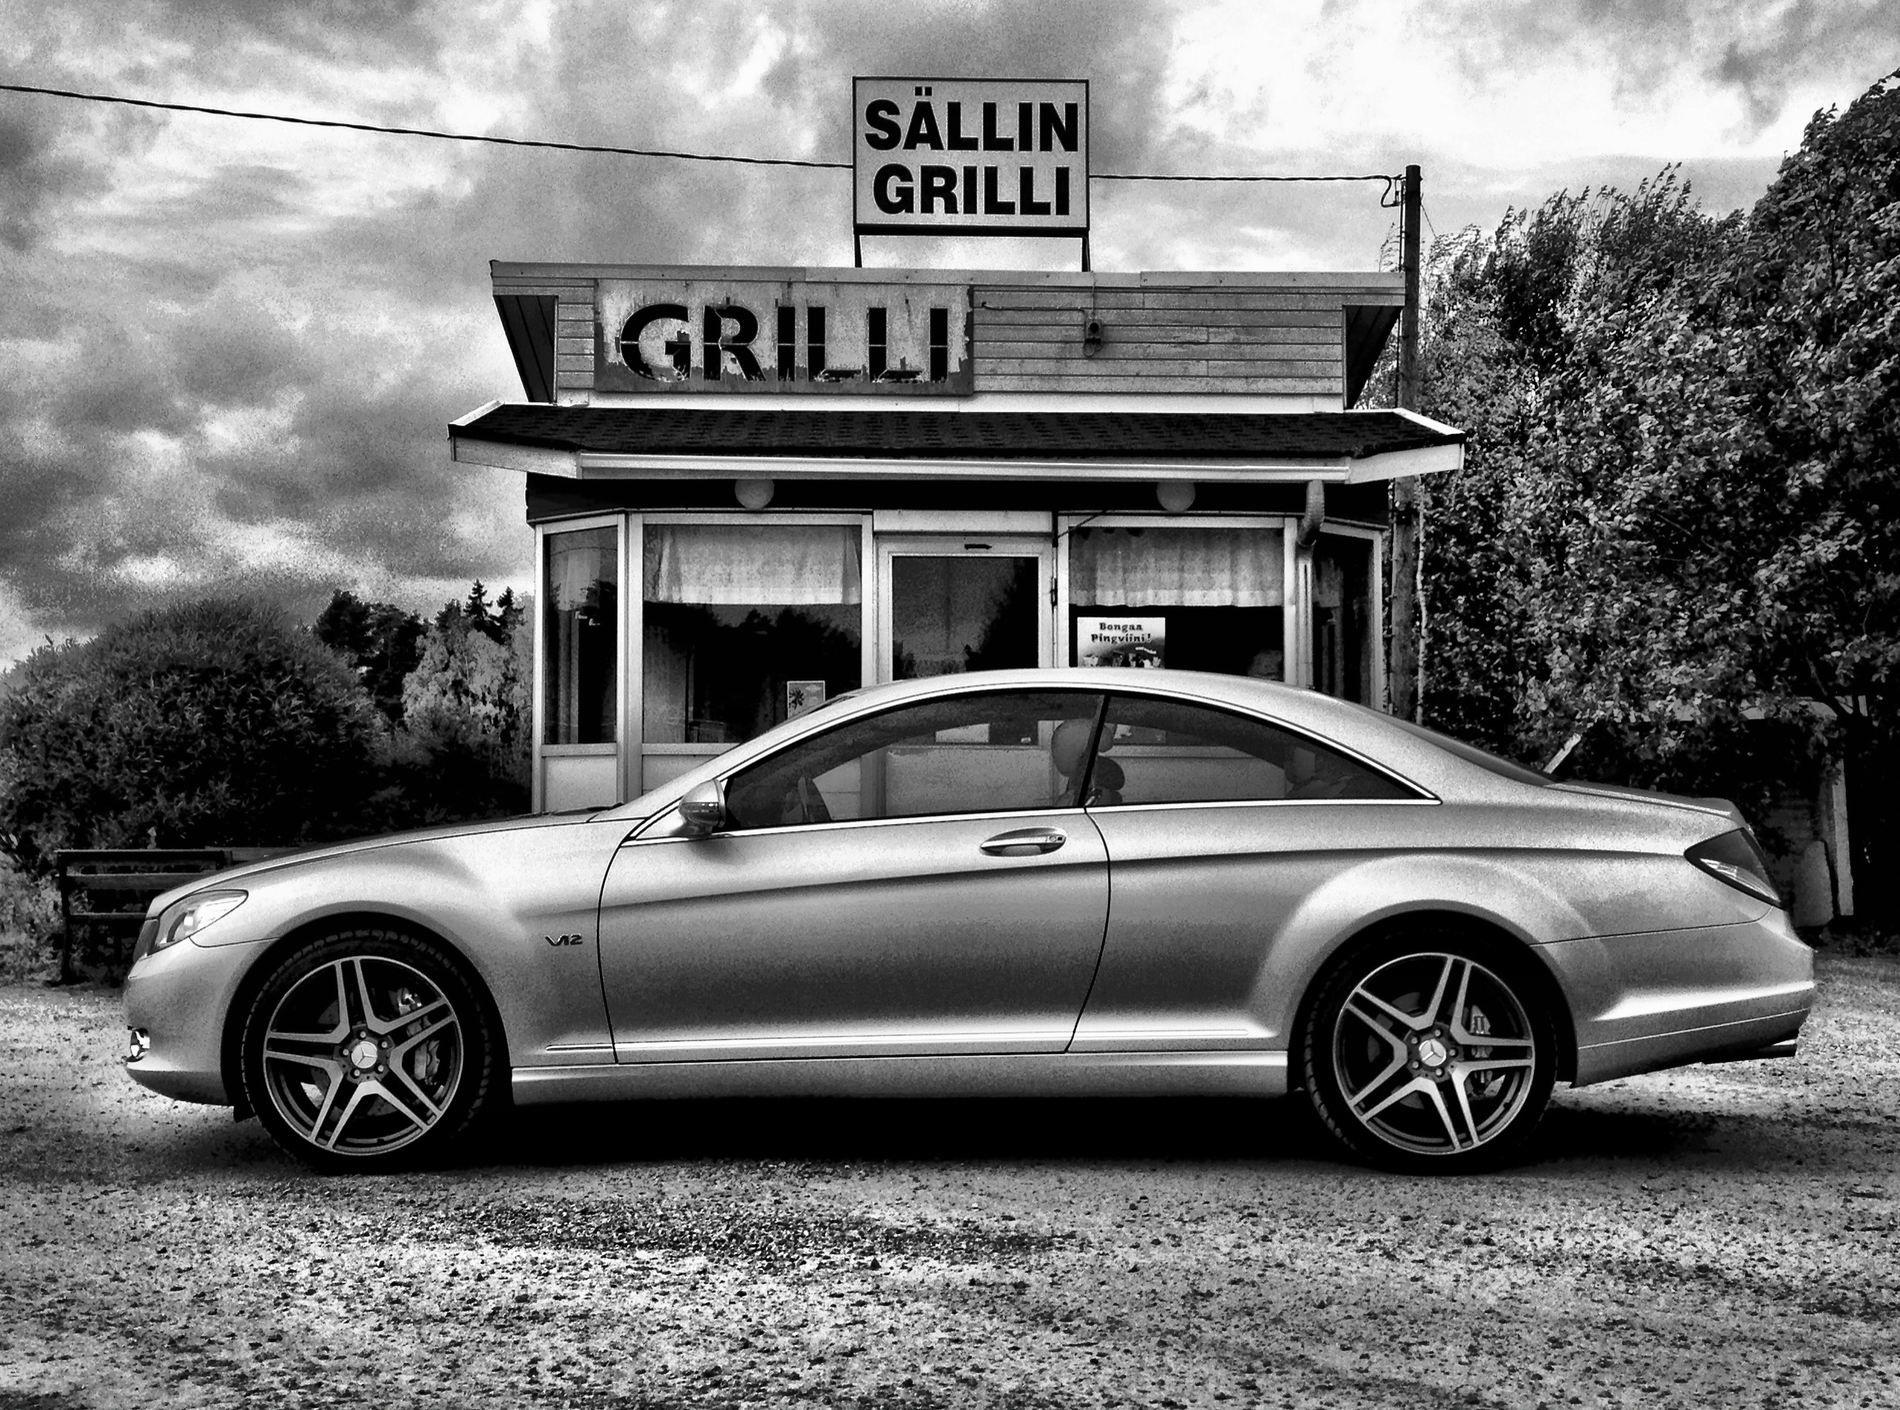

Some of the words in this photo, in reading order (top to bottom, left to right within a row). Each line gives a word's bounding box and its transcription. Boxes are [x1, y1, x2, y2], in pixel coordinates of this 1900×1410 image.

[865, 86, 1078, 152] SÄLLIN
[873, 163, 1070, 216] GRILLI
[620, 303, 948, 383] GRILLI
[1091, 633, 1152, 644] Pingviini!
[1099, 622, 1143, 633] Bongaa
[545, 934, 583, 946] V12
